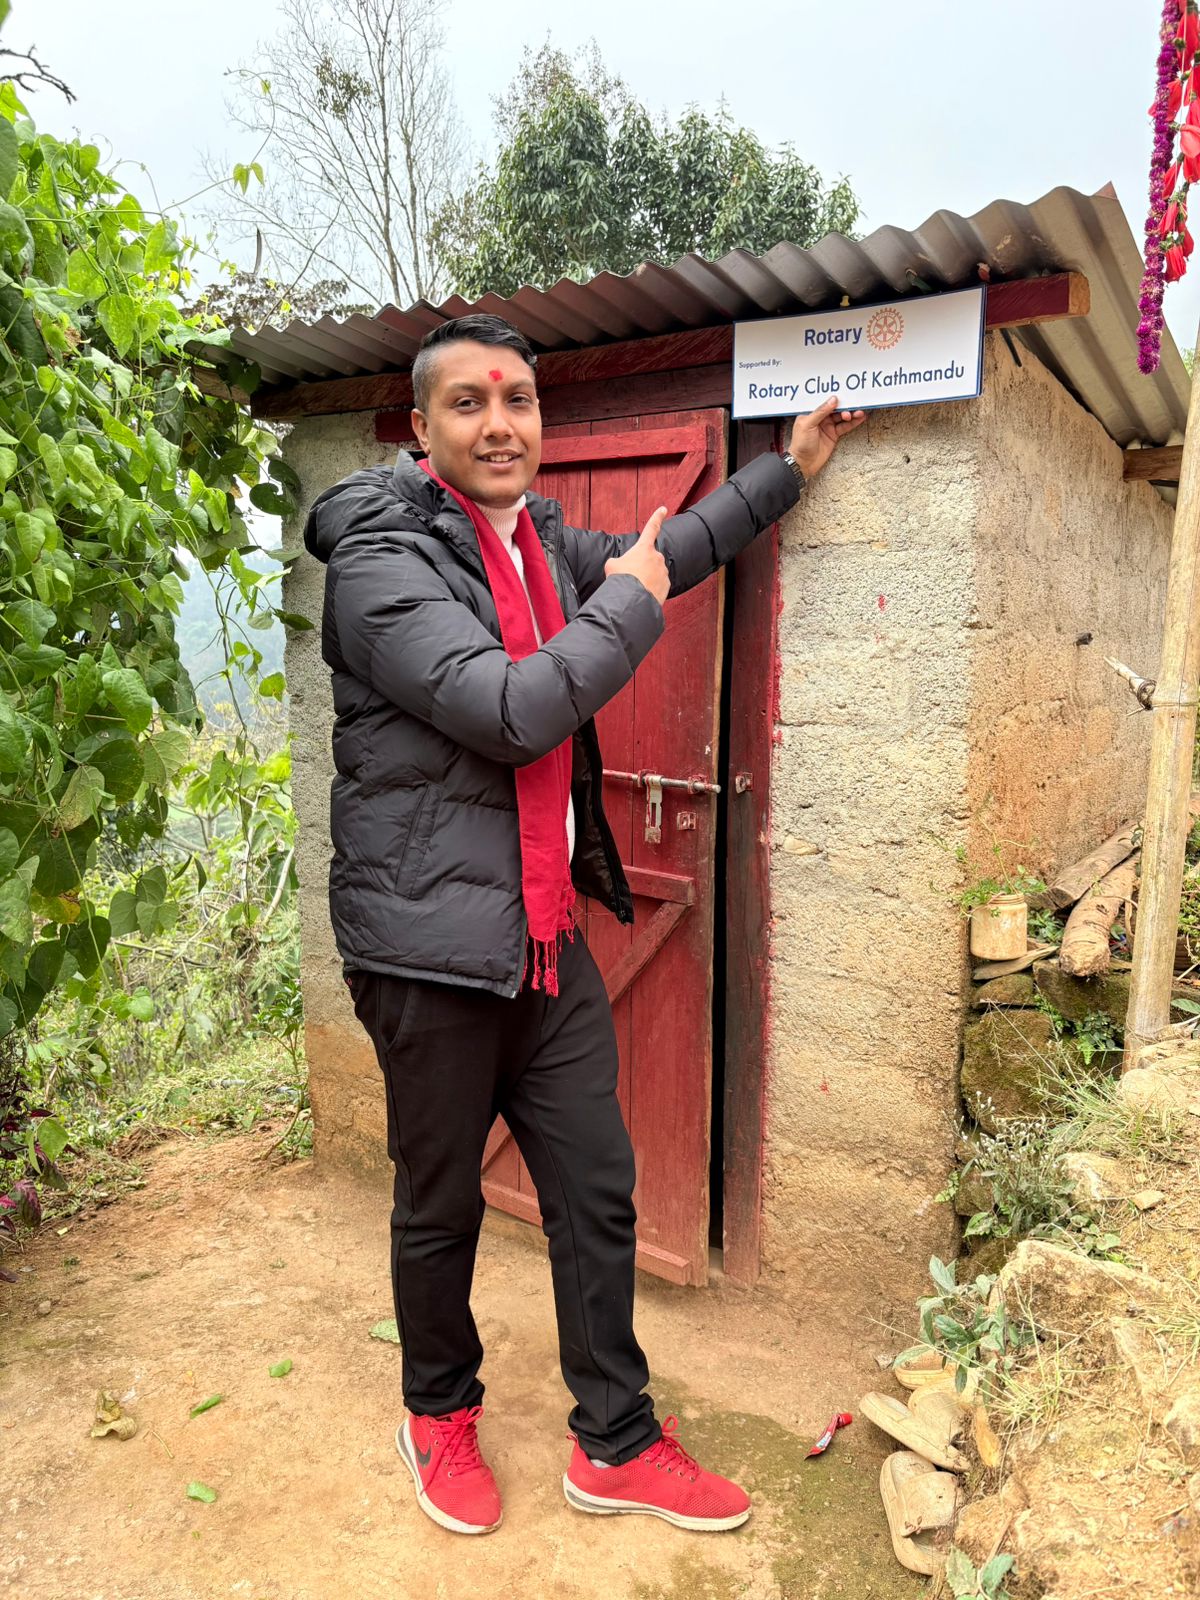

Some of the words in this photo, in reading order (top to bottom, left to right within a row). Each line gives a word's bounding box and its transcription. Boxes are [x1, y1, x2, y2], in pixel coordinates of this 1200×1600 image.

[804, 327, 863, 346] Rotary
[738, 359, 771, 369] Supported
[772, 358, 783, 367] By:
[749, 383, 799, 401] Rotary
[805, 375, 840, 394] Club
[846, 371, 867, 390] Of
[872, 360, 965, 388] Kathmandu
